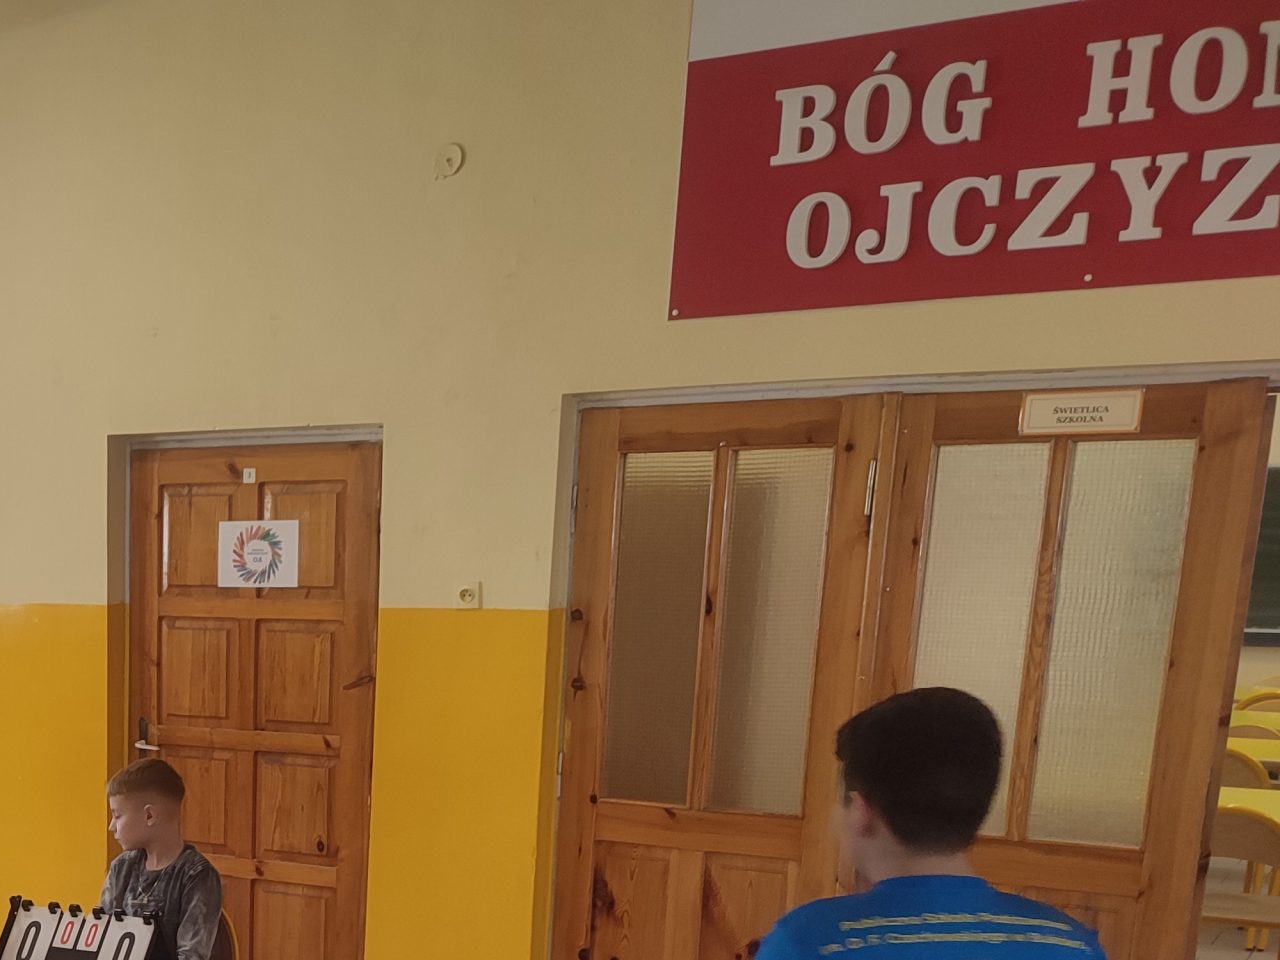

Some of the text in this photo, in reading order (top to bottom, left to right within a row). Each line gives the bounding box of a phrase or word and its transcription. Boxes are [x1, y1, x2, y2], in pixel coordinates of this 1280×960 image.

[770, 51, 992, 167] BÓG
[785, 143, 1280, 269] OJCZYZ
[1053, 405, 1109, 414] ŚWIETLICA
[1056, 415, 1104, 424] SZKOLNA
[60, 920, 74, 945] 0
[84, 923, 99, 947] 0
